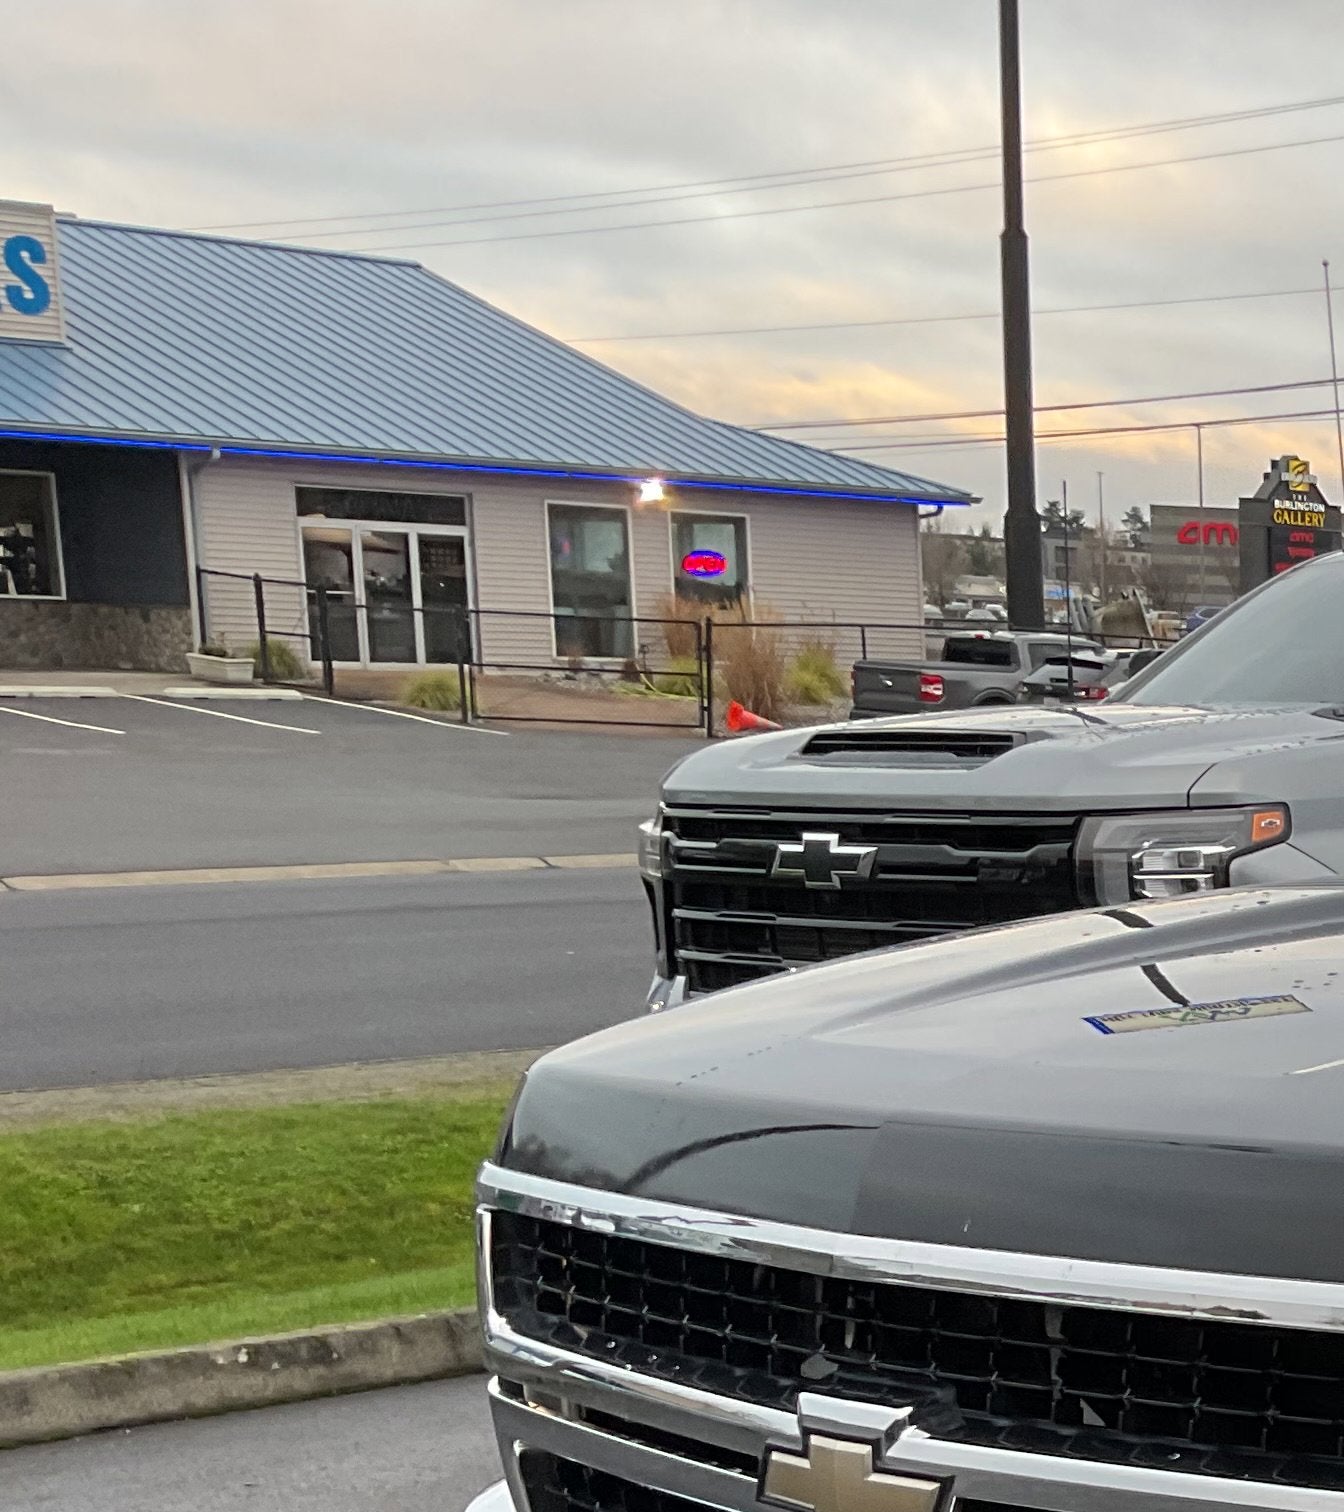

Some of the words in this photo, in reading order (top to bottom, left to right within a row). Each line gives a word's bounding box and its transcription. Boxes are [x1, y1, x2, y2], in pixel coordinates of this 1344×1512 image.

[0, 235, 50, 316] S
[1273, 499, 1325, 512] BURLINGTON
[1273, 510, 1325, 527] GALLERY
[1177, 521, 1240, 545] am
